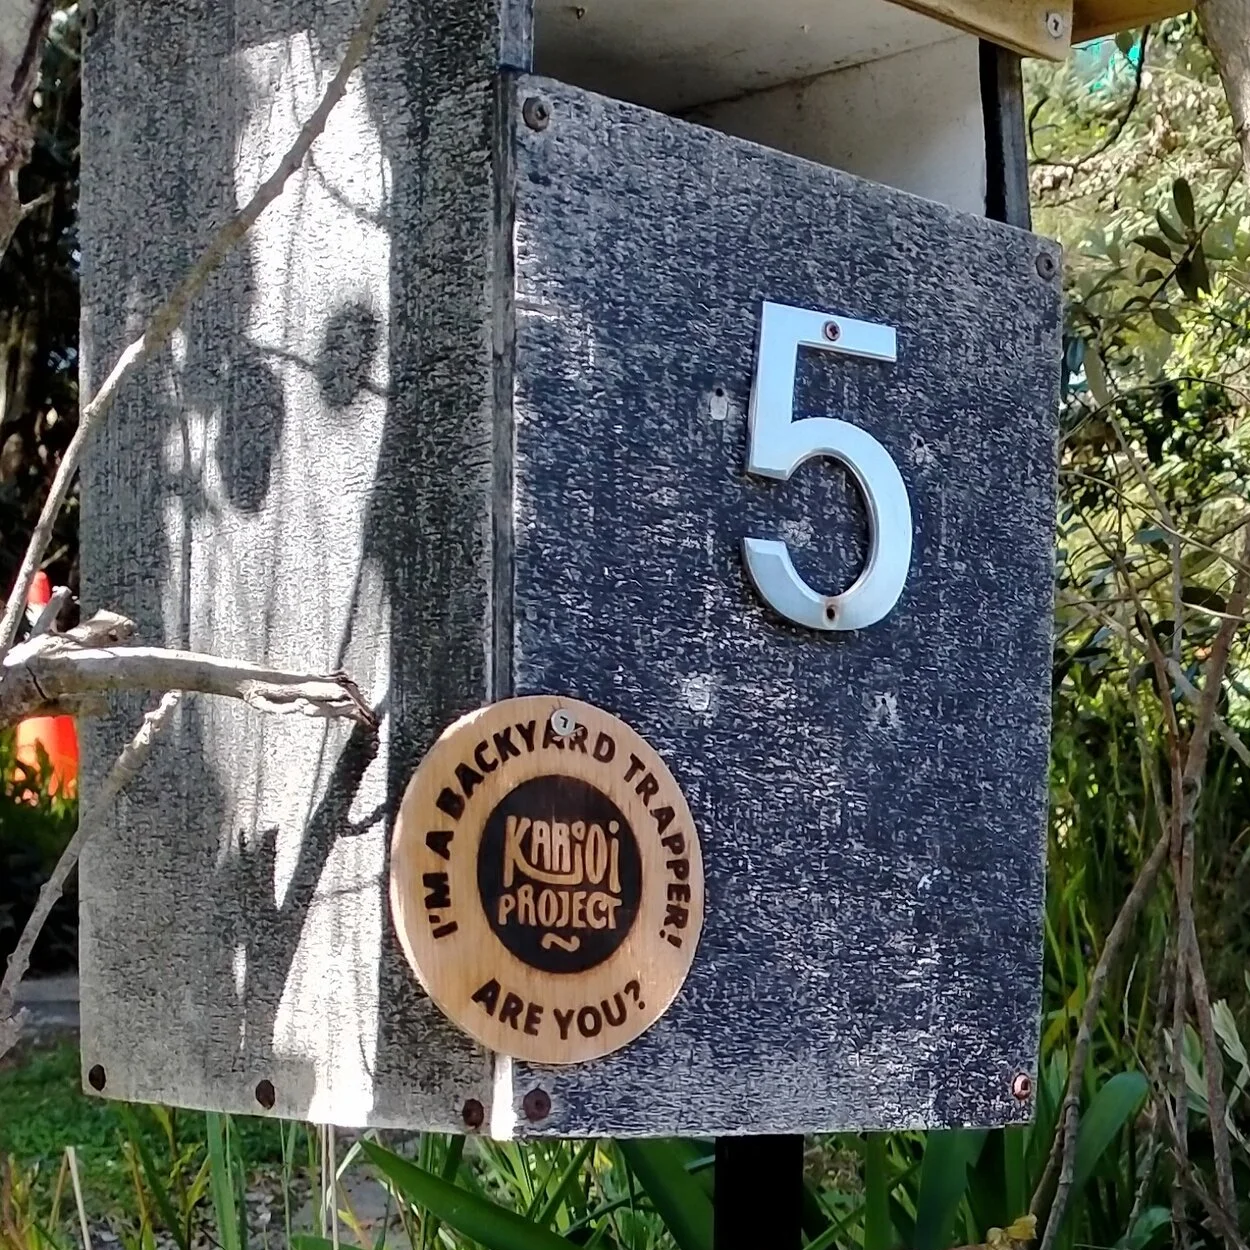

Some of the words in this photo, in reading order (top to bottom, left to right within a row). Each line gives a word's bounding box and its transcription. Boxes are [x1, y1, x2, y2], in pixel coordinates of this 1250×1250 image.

[741, 300, 912, 631] 5
[436, 719, 615, 819] BACKYARD
[426, 830, 453, 861] A
[623, 753, 691, 949] TRAPPER!
[423, 872, 458, 939] I'M
[499, 884, 622, 930] PROJECT
[471, 978, 543, 1036] ARE
[553, 979, 646, 1040] YOU?
